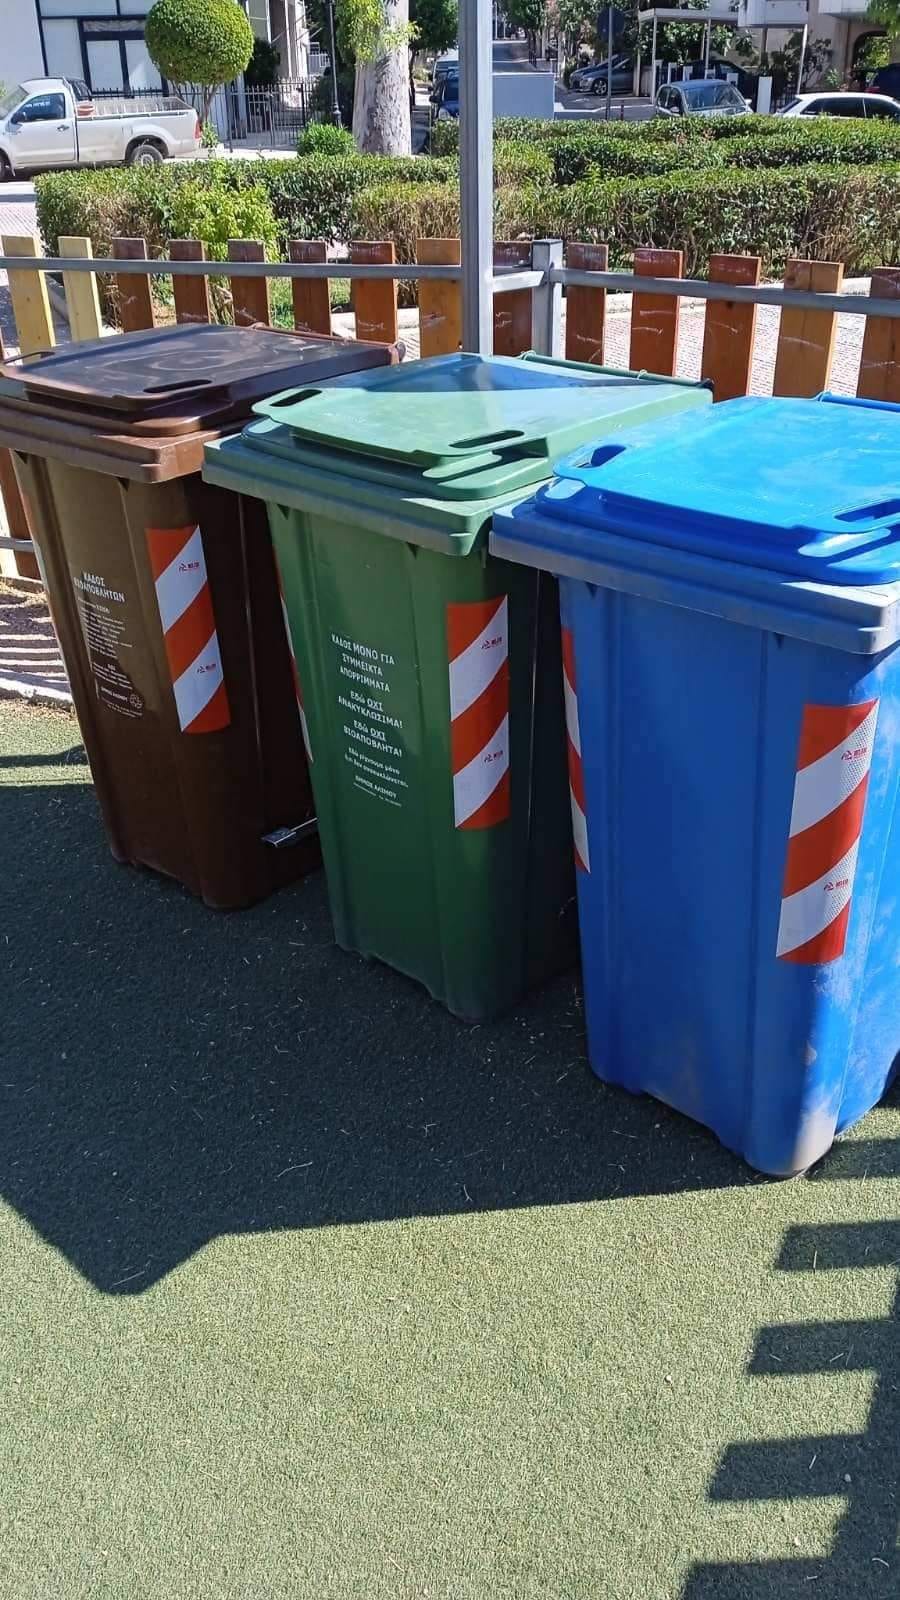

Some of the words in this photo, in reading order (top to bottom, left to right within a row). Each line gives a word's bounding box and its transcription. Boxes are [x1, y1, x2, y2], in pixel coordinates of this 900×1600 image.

[331, 633, 352, 651] ΚΑΔΟΣ
[352, 643, 378, 660] ΜΟΝΟ
[380, 653, 395, 664] ΓΙΑ
[342, 653, 383, 676] ΣΥΜΜΕΙΚΤΑ
[340, 665, 390, 692] ΑΠΟΡΡΙΜΜΑΤΑ
[338, 695, 403, 728] ΑΝΑΚΥΚΛΩΣΙΜΑ!
[367, 698, 383, 712] ΟΧΙ
[370, 727, 386, 742] ΟΧΙ
